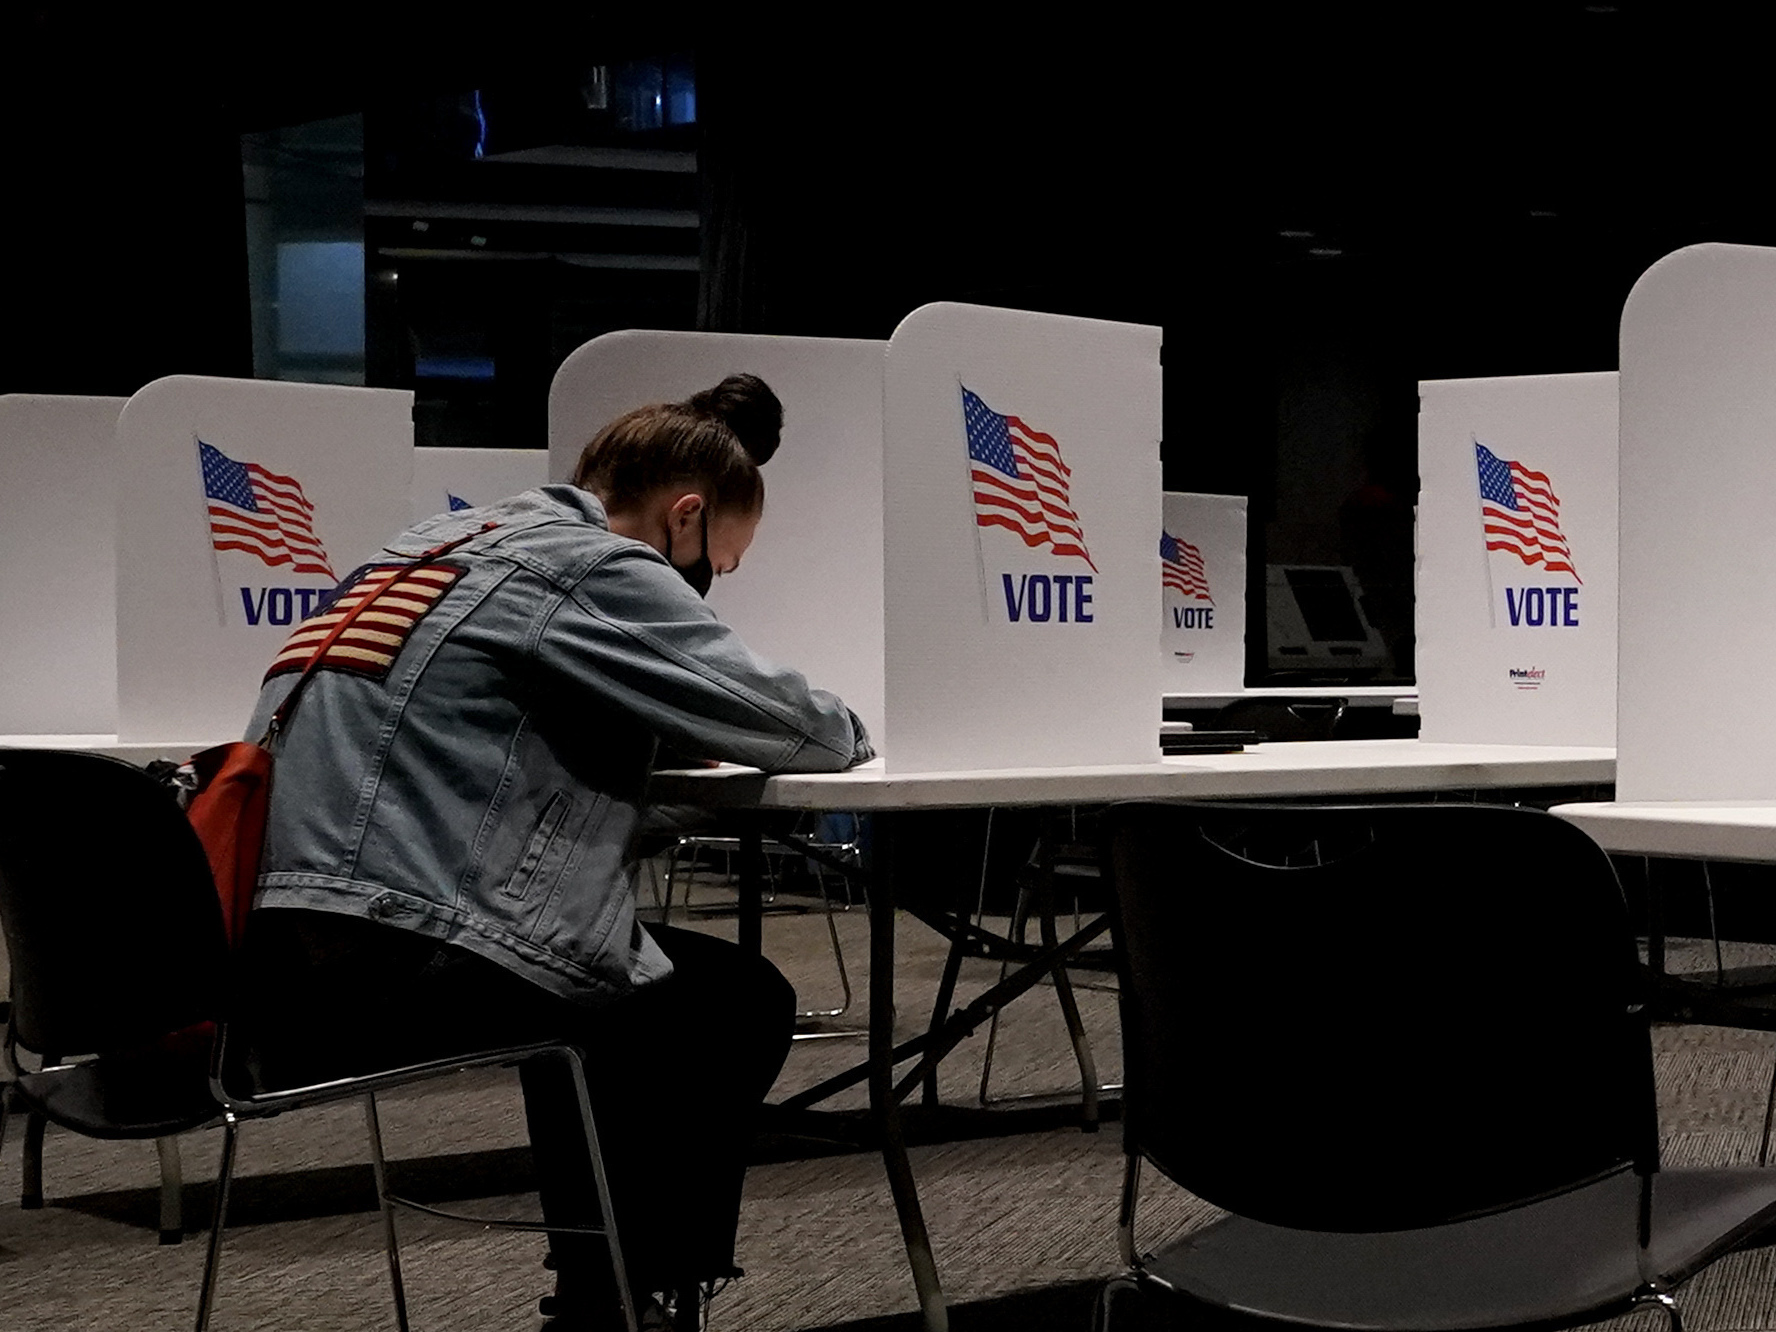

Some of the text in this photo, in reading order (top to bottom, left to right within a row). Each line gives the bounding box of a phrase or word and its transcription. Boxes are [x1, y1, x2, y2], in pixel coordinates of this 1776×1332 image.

[1002, 573, 1094, 623] VOTE
[1173, 606, 1214, 630] VOTE
[1505, 587, 1580, 627] VOTE
